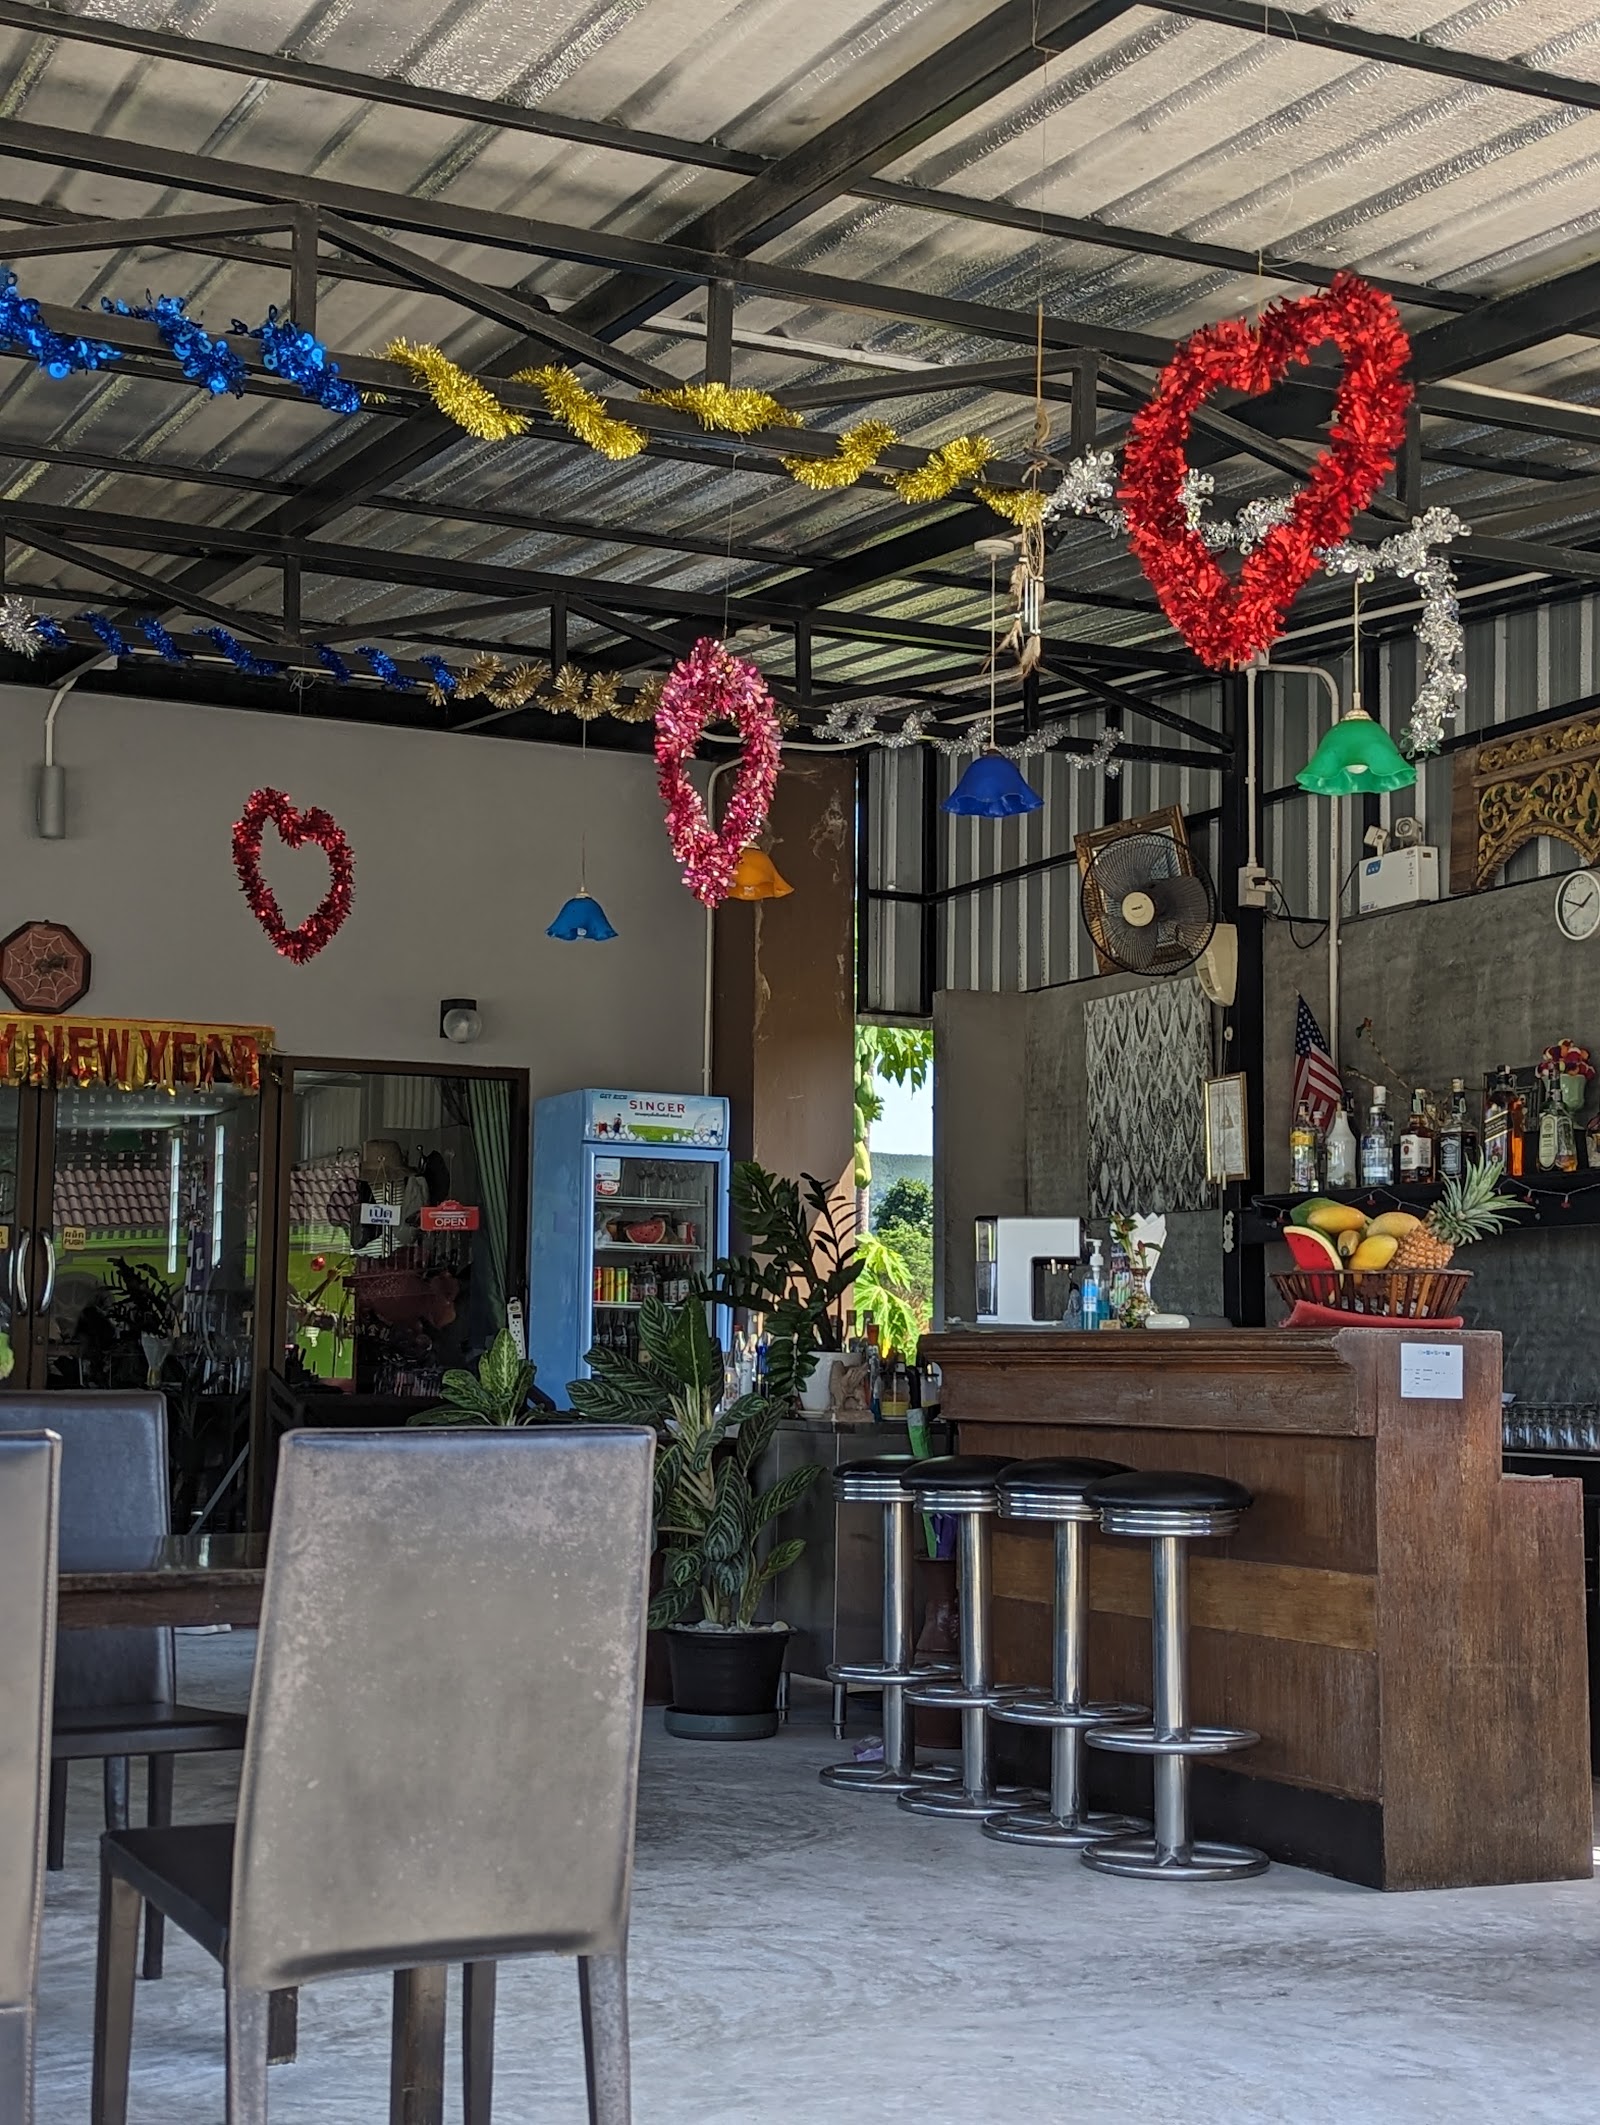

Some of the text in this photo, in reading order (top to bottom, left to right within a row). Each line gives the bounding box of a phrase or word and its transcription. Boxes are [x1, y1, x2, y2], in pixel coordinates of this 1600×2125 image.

[33, 1024, 129, 1083] NEW
[629, 1100, 686, 1113] SINGER
[369, 1205, 392, 1218] เปิด
[435, 1217, 466, 1227] OPEN
